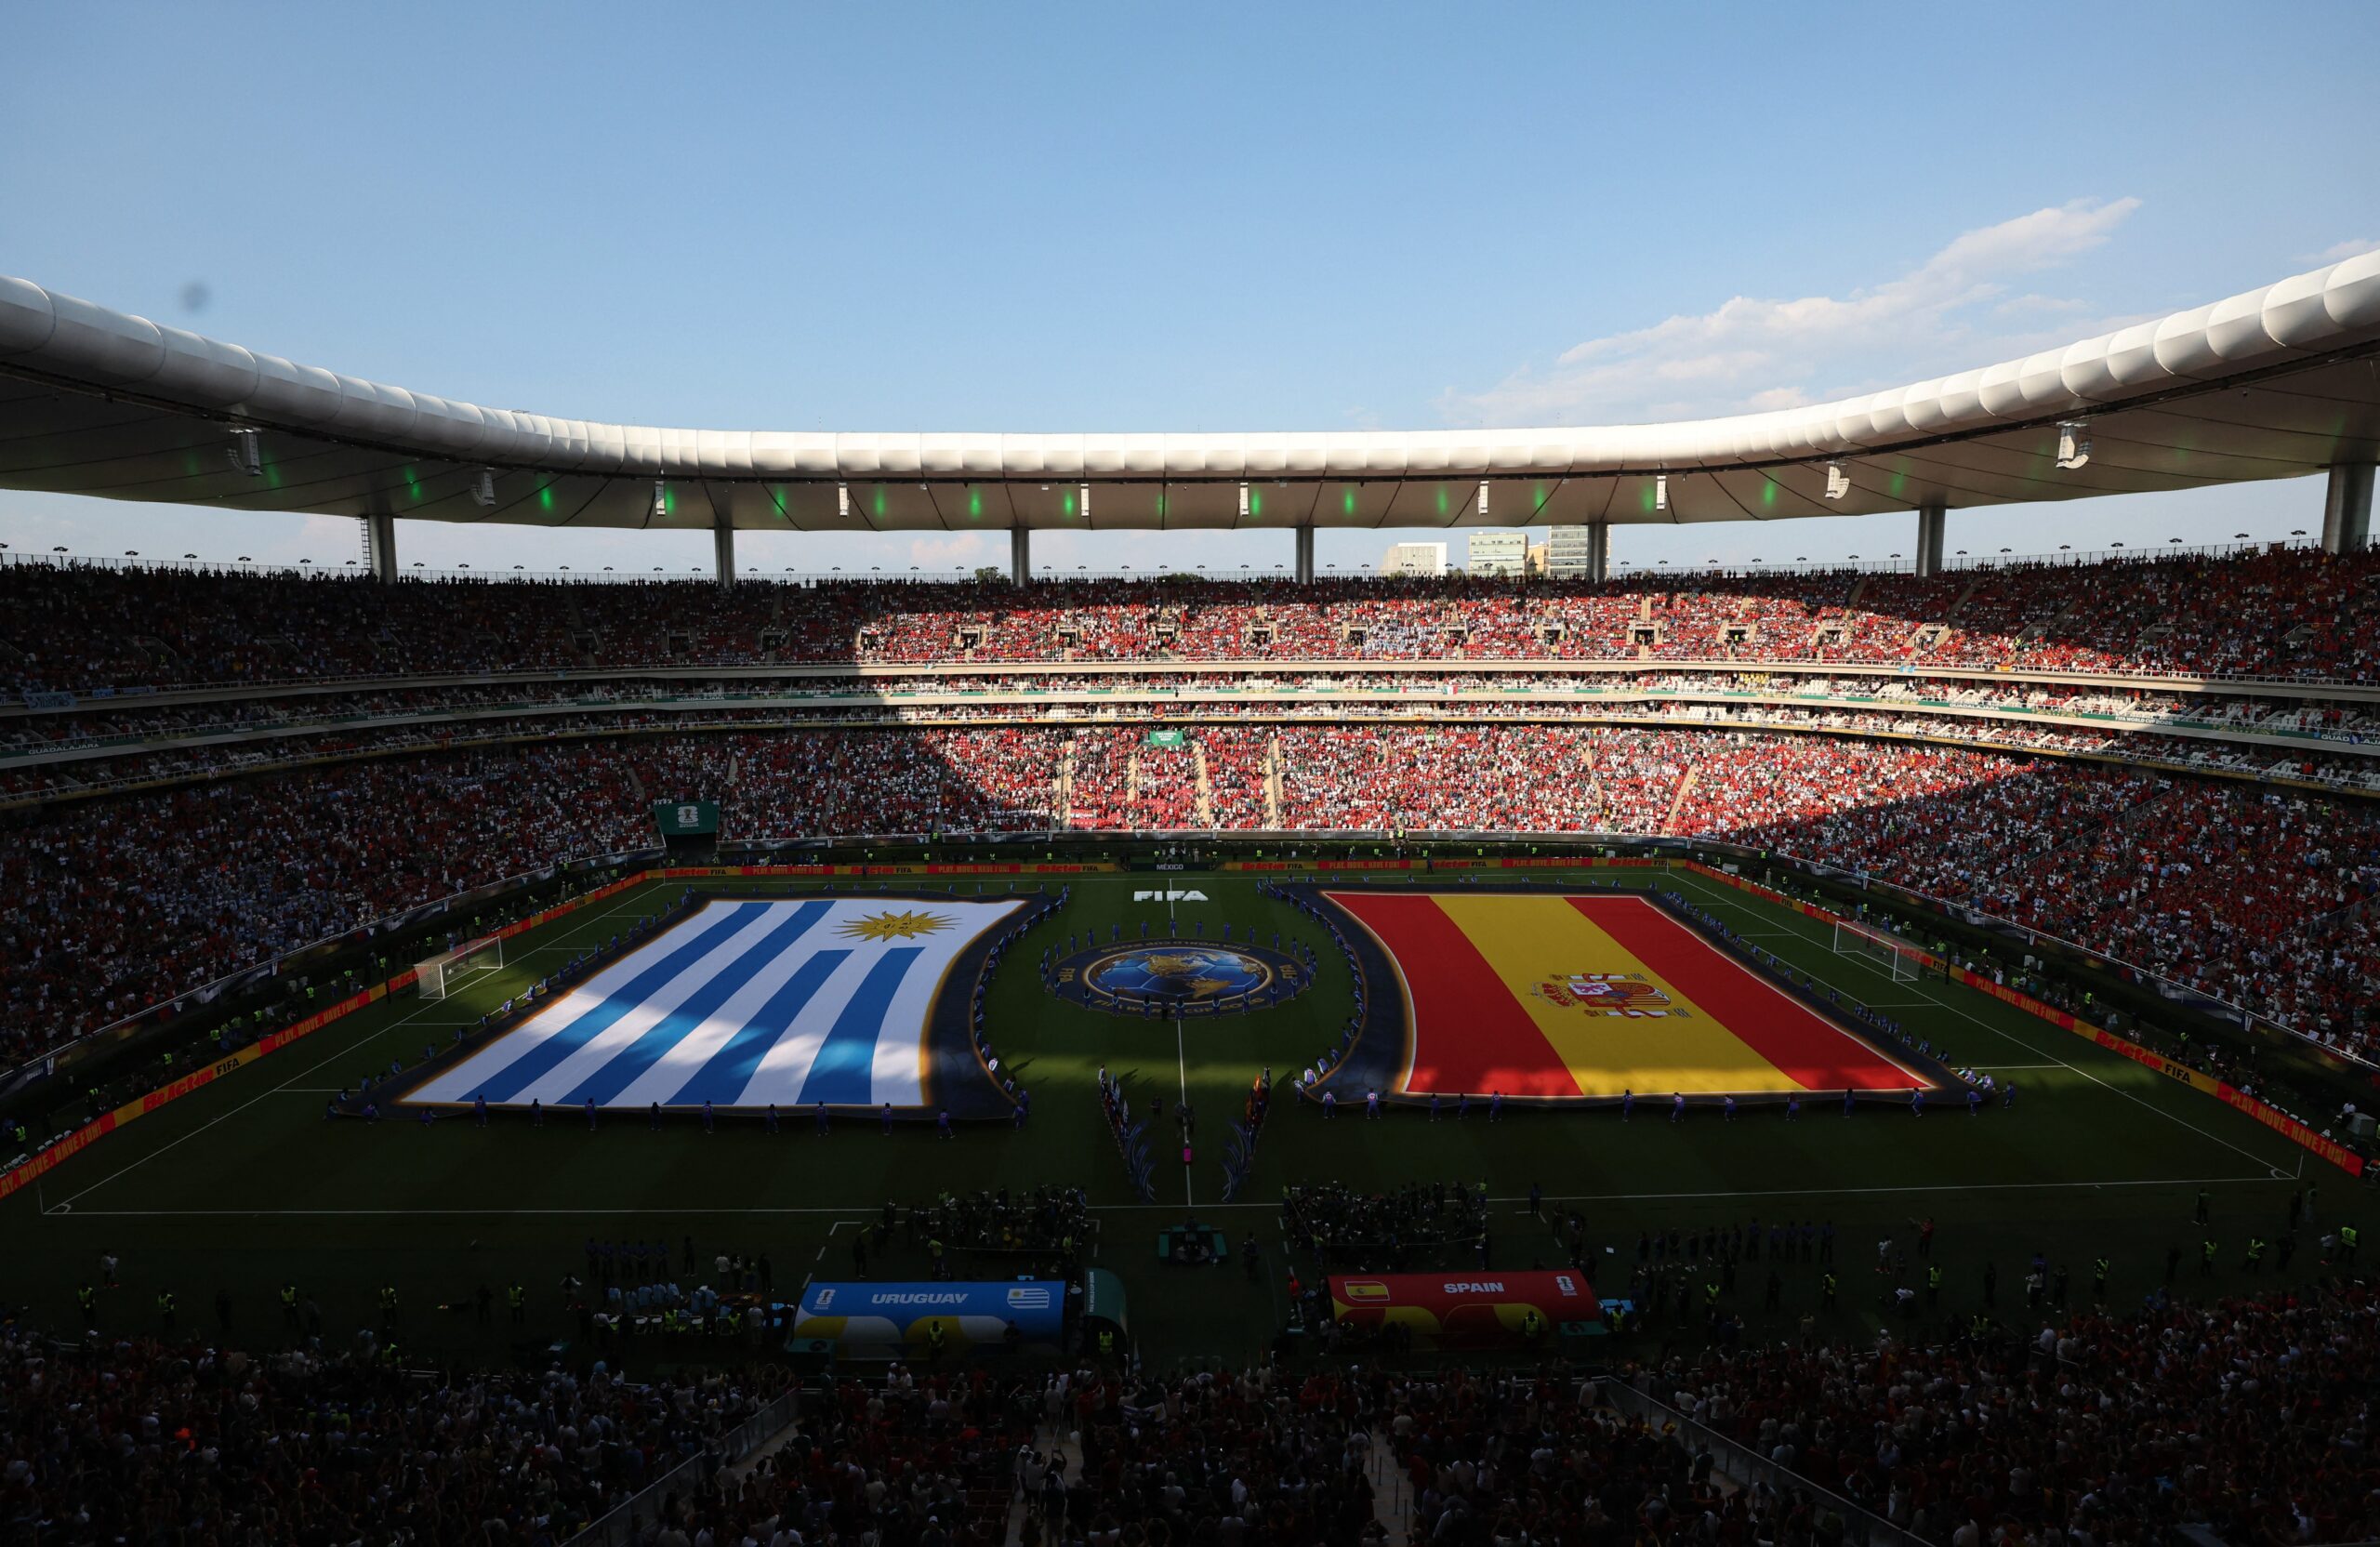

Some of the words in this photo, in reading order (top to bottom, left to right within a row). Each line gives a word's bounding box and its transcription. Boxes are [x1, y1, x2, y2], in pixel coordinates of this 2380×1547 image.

[1950, 701, 2000, 711] GUADALAJARA
[28, 744, 99, 755] GUADALAJARA
[1157, 862, 1183, 871] MÉXICO
[1133, 890, 1209, 902] FIFA
[1976, 977, 1994, 993] PLAY.
[1995, 985, 2019, 1005] MOVE.
[2020, 996, 2040, 1016] HAVE
[2040, 1007, 2060, 1024] FUN!
[275, 1026, 298, 1048] PLAY.
[298, 1017, 323, 1037] MOVE.
[323, 1006, 342, 1025] HAVE
[342, 998, 359, 1017] FUN!
[2095, 1030, 2115, 1049] Be
[2115, 1039, 2162, 1070] Active
[216, 1058, 241, 1076] FIFA
[2164, 1063, 2190, 1084] FIFA
[143, 1091, 165, 1113] Be
[167, 1068, 214, 1102] Active
[2231, 1091, 2256, 1116] PLAY.
[2257, 1108, 2289, 1136] MOVE.
[2290, 1126, 2318, 1152] HAVE
[2318, 1140, 2347, 1166] FUN!
[19, 1152, 55, 1186] MOVE.
[54, 1133, 80, 1164] HAVE
[79, 1121, 102, 1149] FUN!
[1443, 1281, 1505, 1294] SPAIN
[871, 1293, 969, 1304] URUGUAY
